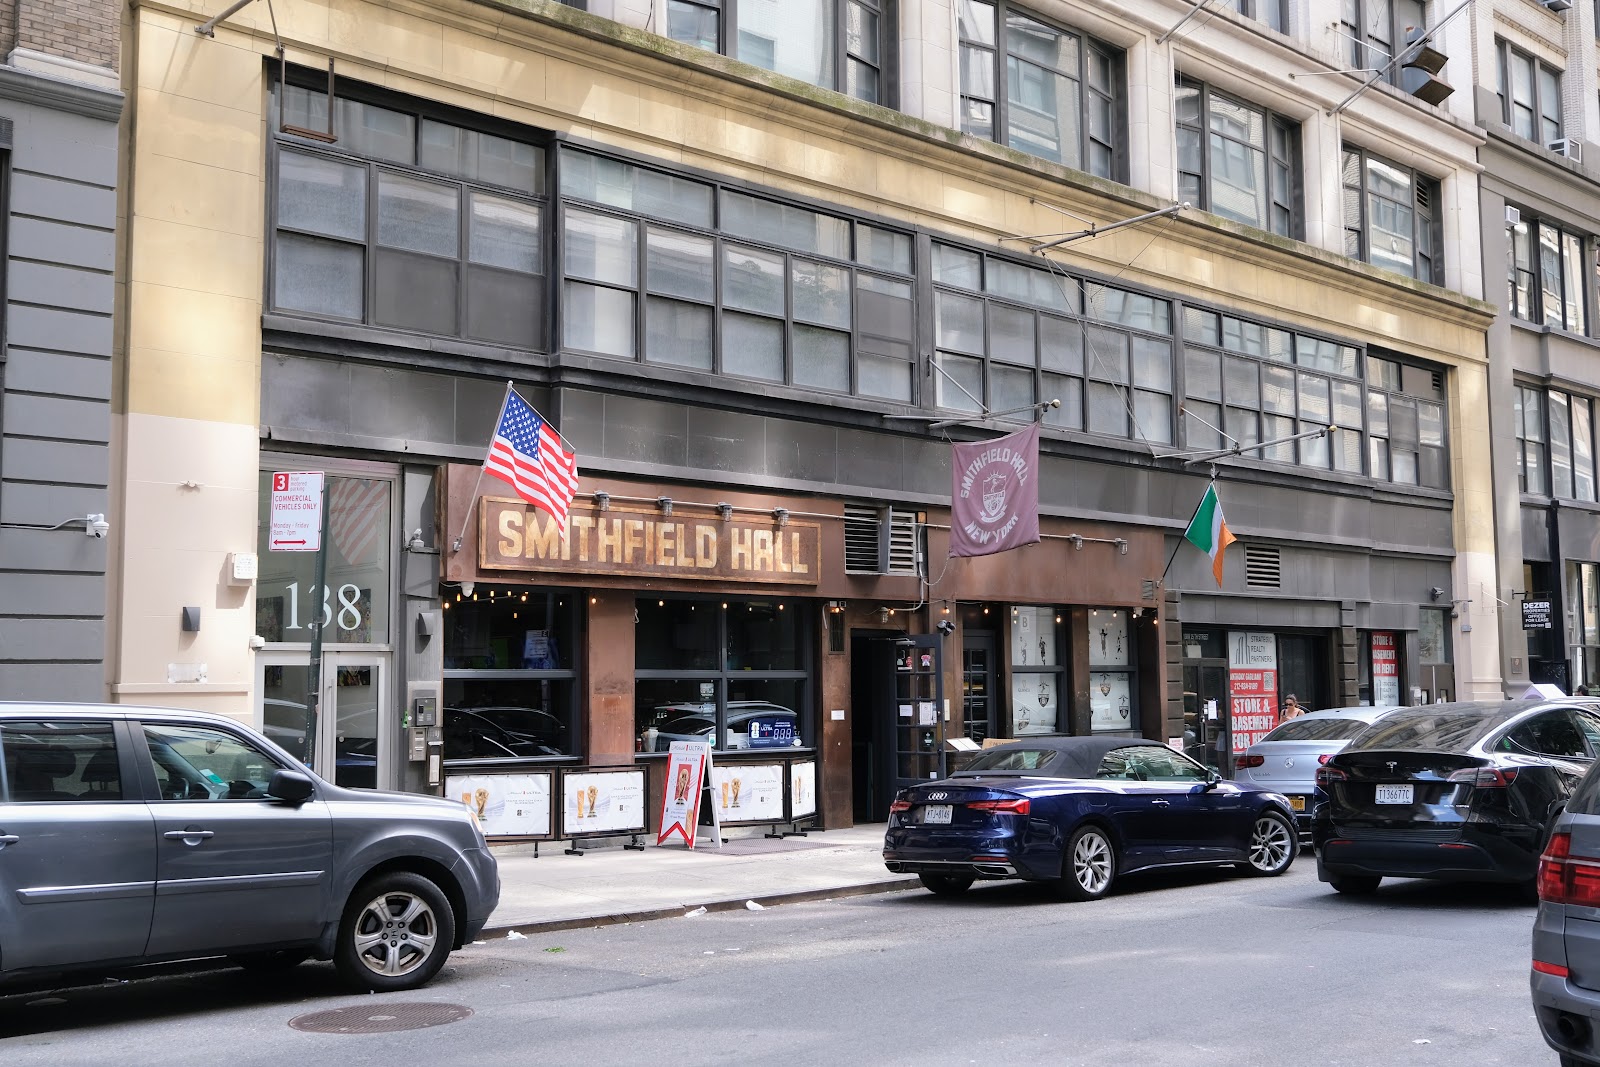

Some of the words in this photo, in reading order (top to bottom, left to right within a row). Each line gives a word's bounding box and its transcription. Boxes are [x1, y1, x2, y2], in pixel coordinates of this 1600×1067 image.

[960, 448, 1010, 498] SMITHFIELD
[1010, 452, 1028, 486] HALL
[277, 475, 286, 490] 3
[965, 520, 990, 544] NEW
[992, 512, 1018, 543] YORK
[498, 510, 718, 568] SMITHFIELD
[731, 527, 808, 574] HALL
[1022, 616, 1028, 628] B
[1372, 636, 1388, 646] STORE
[1389, 636, 1393, 645] &
[1373, 650, 1395, 659] ASEMENT
[1382, 664, 1395, 674] RENT
[1234, 698, 1261, 713] STORE
[1263, 699, 1270, 712] &
[1232, 716, 1274, 730] BASEMENT
[1232, 733, 1250, 748] FOR
[1379, 790, 1410, 800] T136677C
